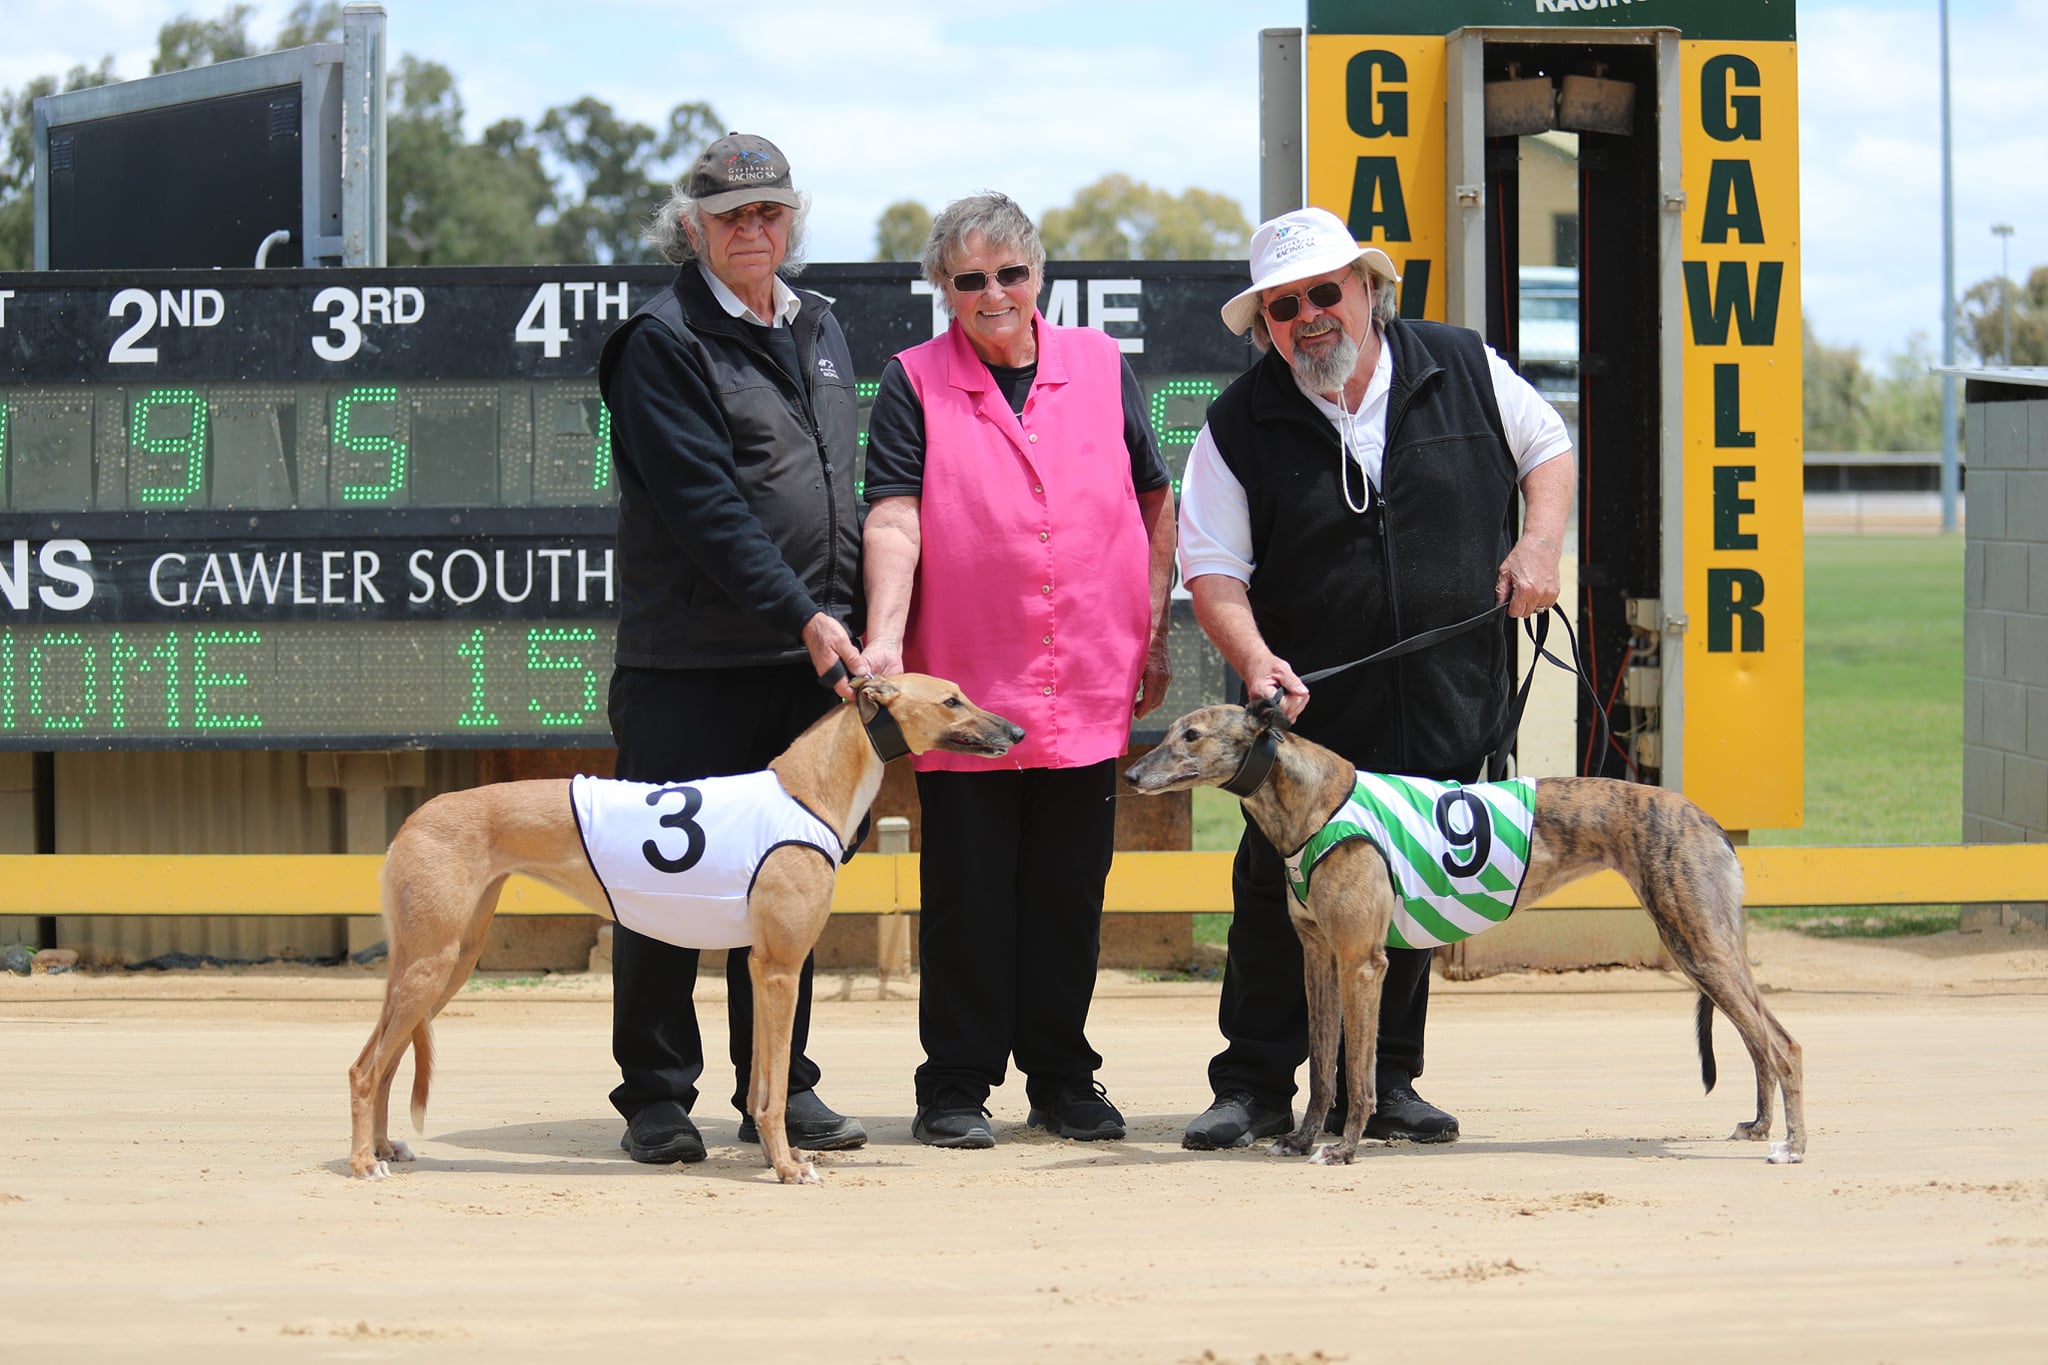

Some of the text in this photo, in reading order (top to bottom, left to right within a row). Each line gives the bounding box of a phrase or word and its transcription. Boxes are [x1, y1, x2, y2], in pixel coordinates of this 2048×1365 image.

[728, 171, 777, 182] RACING SA
[108, 279, 1144, 363] 2ND 3RD 4TH TE
[1683, 54, 1784, 653] GAWLER
[132, 389, 207, 502] 9
[333, 387, 407, 500] 5
[149, 549, 614, 607] GAWLER SOUTH
[1, 630, 262, 729] OME
[457, 628, 598, 727] 15
[642, 786, 706, 874] 3
[1435, 789, 1491, 878] 9
